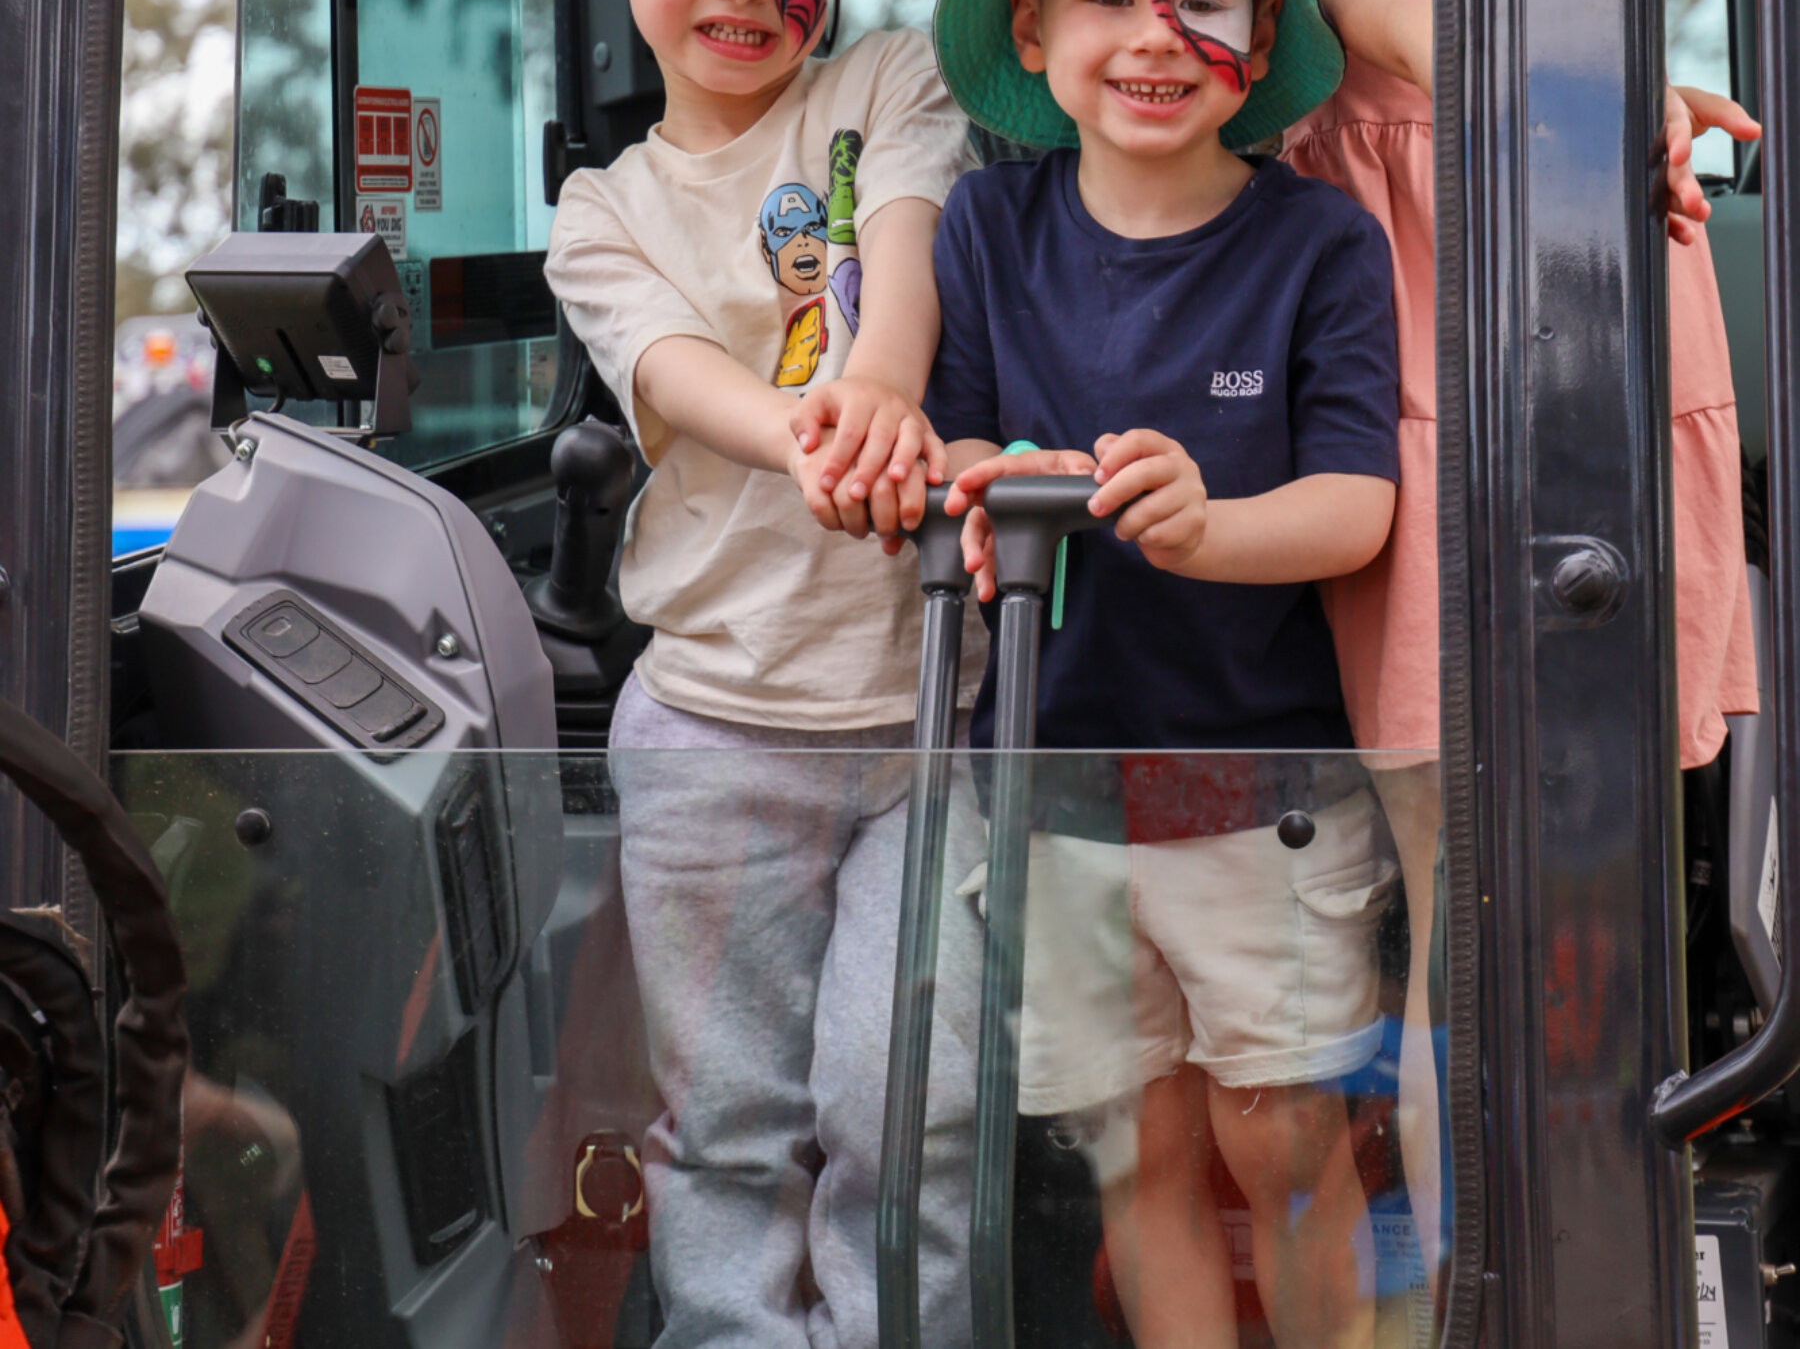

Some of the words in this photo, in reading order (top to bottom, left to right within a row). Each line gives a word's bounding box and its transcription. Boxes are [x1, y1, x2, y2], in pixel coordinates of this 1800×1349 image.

[376, 217, 390, 232] YOU
[391, 217, 402, 232] DIG
[1211, 370, 1264, 389] BOSS
[1211, 388, 1238, 397] HUGO
[1240, 385, 1263, 396] BOSS
